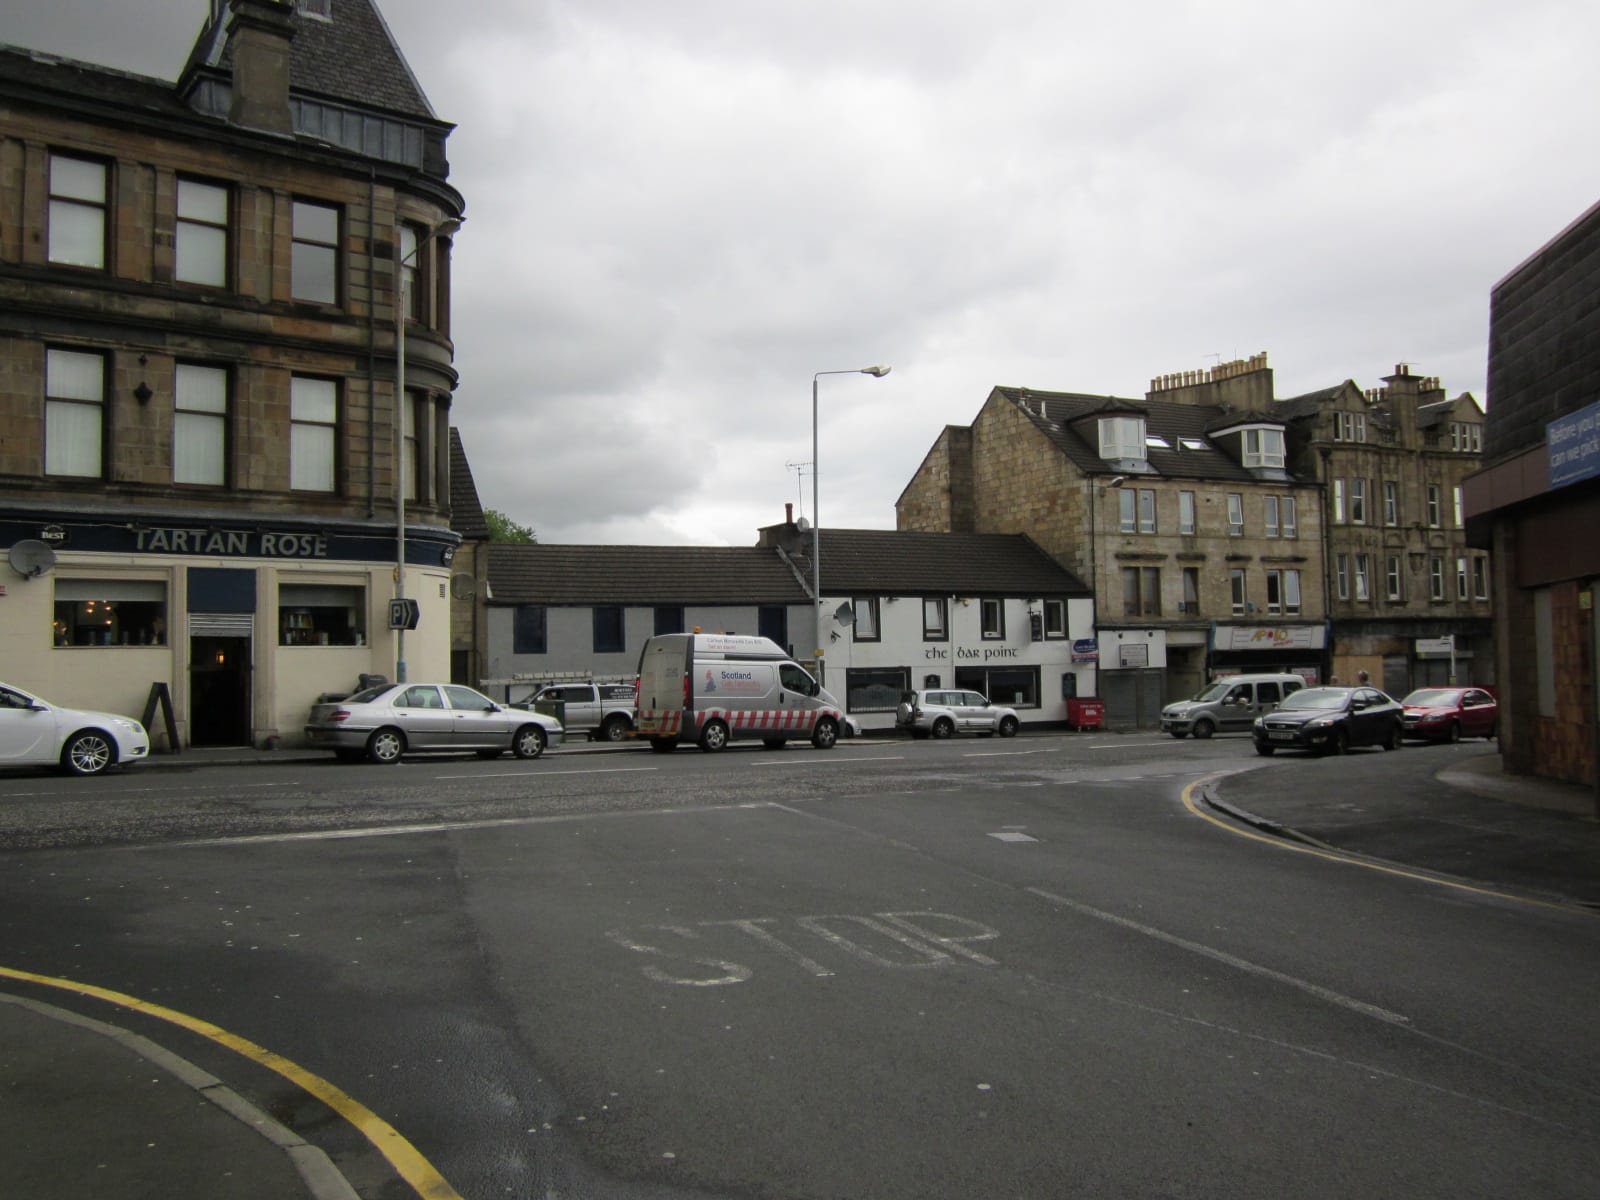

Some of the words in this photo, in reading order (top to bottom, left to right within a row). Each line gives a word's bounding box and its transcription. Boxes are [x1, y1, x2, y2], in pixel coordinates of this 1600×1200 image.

[133, 529, 247, 554] TARTAN
[261, 534, 328, 557] ROSE
[393, 606, 401, 624] P
[984, 645, 1018, 662] point
[721, 671, 752, 680] Scotland
[604, 911, 1001, 987] STOP
